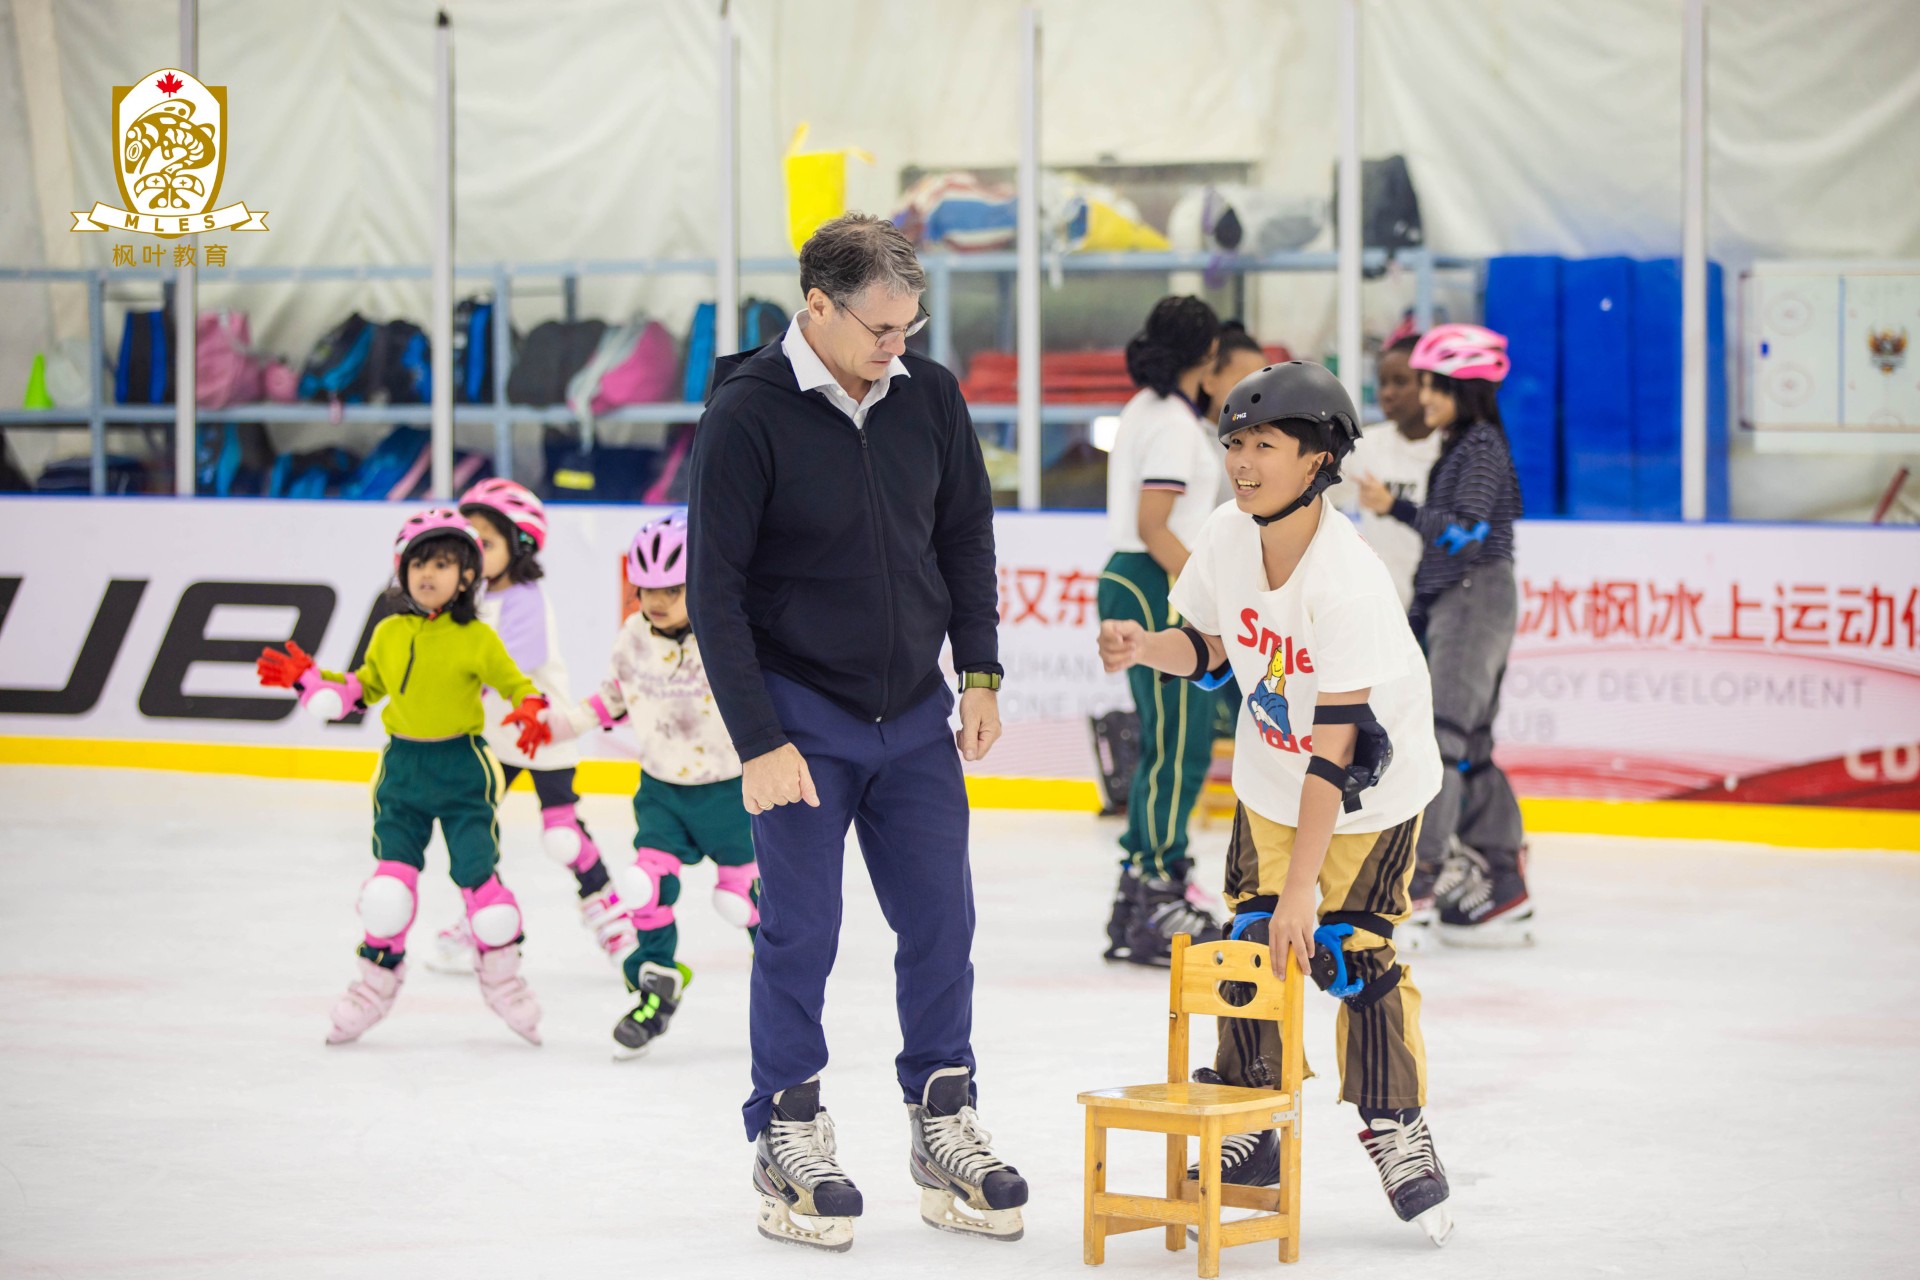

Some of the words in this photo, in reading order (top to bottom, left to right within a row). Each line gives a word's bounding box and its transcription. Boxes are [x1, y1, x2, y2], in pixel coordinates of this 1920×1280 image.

[1001, 654, 1097, 683] UHAN
[1508, 666, 1587, 700] OGY
[1600, 668, 1866, 709] DEVELOPMENT
[1508, 708, 1557, 742] UB
